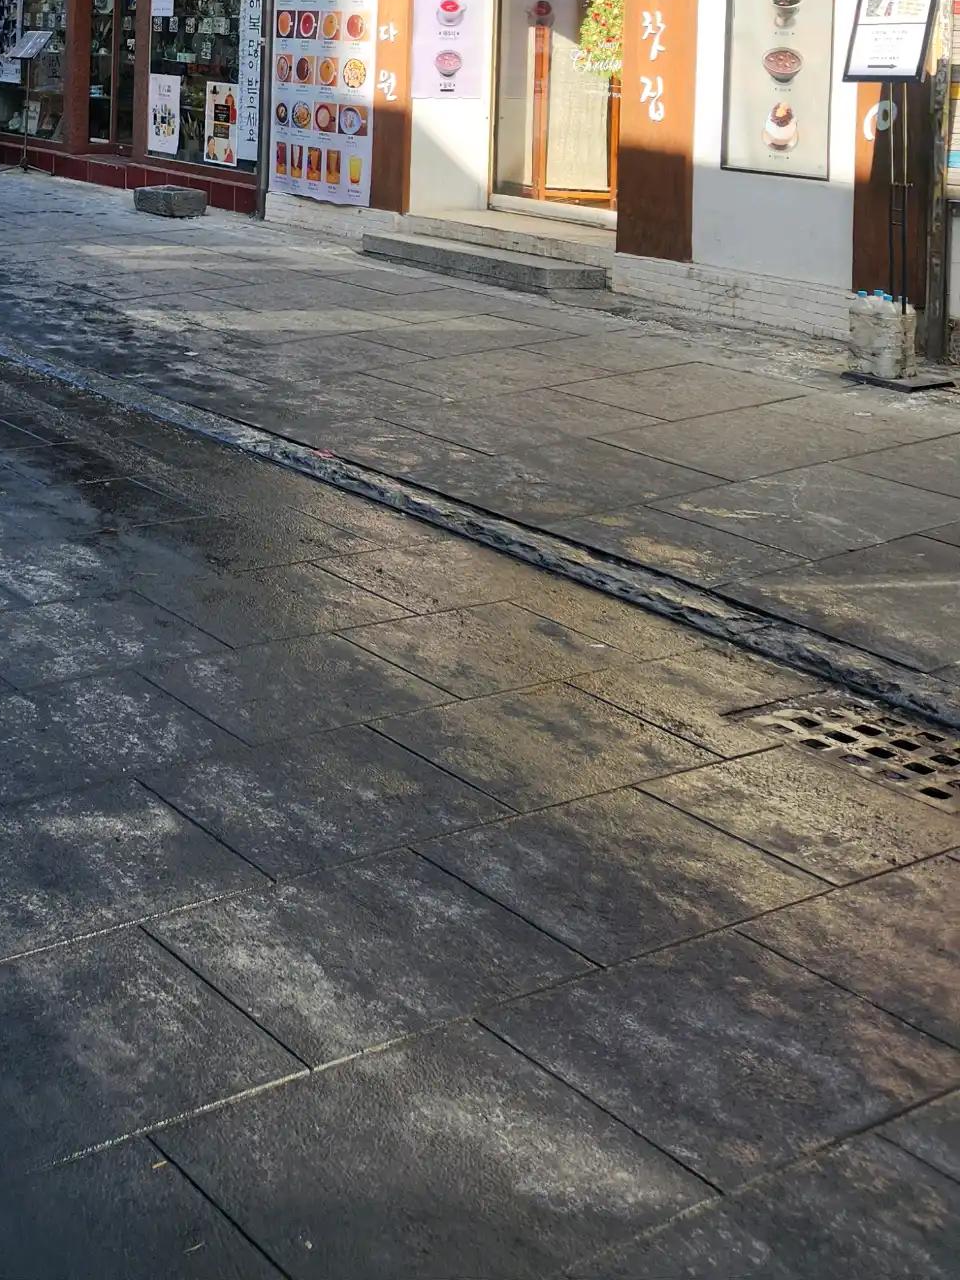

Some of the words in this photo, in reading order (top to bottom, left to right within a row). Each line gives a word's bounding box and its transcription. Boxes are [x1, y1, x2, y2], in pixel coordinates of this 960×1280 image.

[249, 16, 260, 35] 복
[248, 40, 261, 71] 많이
[246, 77, 259, 143] 받으세요
